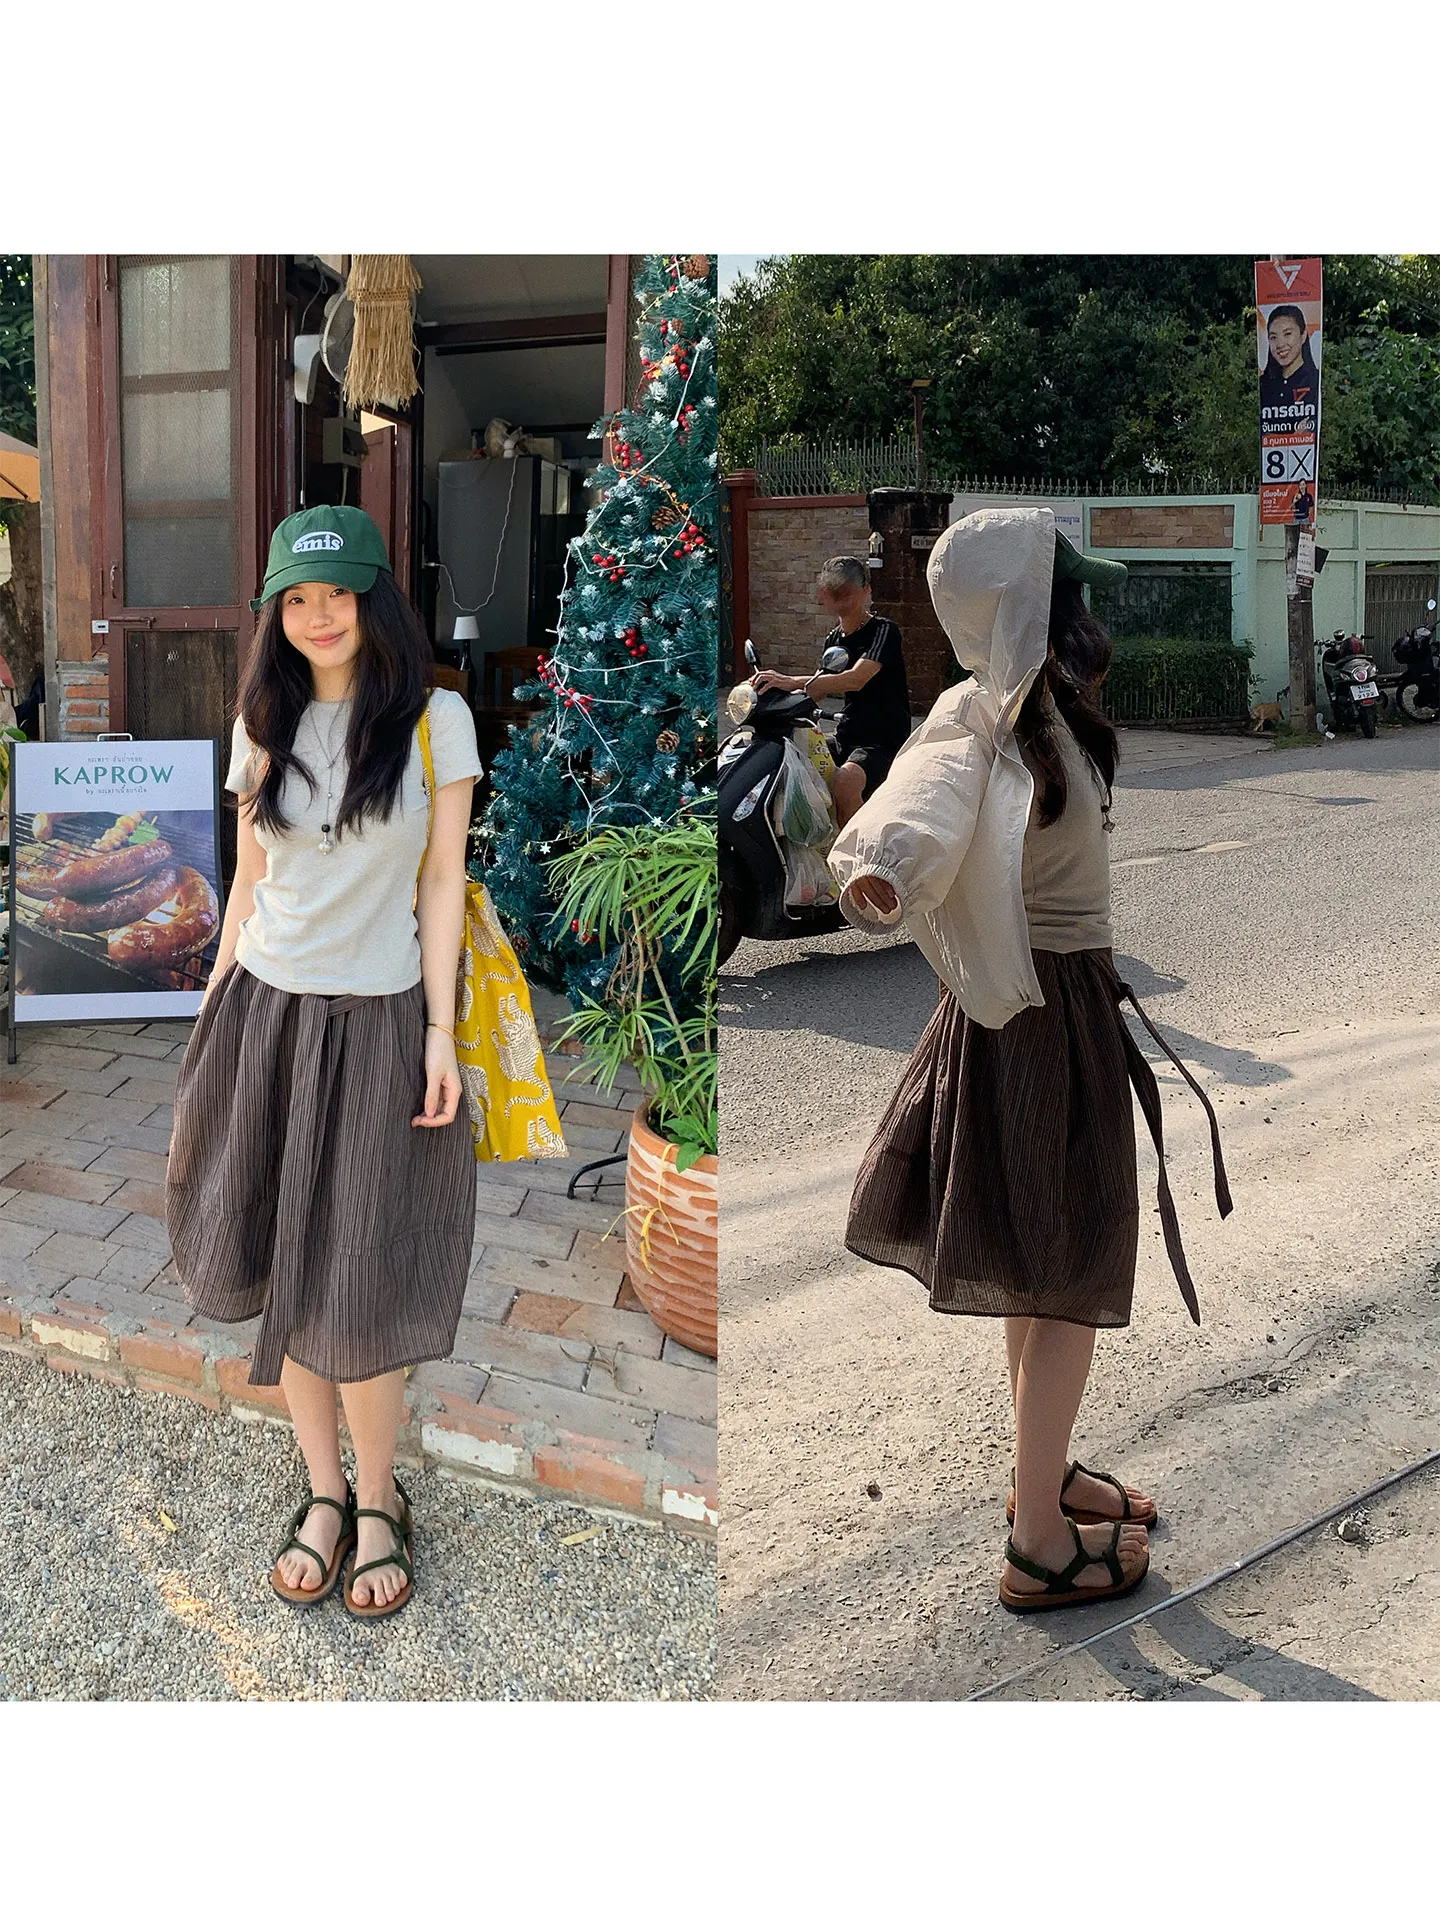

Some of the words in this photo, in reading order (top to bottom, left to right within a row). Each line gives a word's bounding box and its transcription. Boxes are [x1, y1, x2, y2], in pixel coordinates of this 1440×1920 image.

[1262, 401, 1316, 419] การณิก
[1261, 421, 1292, 433] จันทดา
[1266, 450, 1285, 479] 8
[292, 533, 341, 554] emis
[54, 765, 174, 785] KAPROW
[86, 788, 94, 796] by
